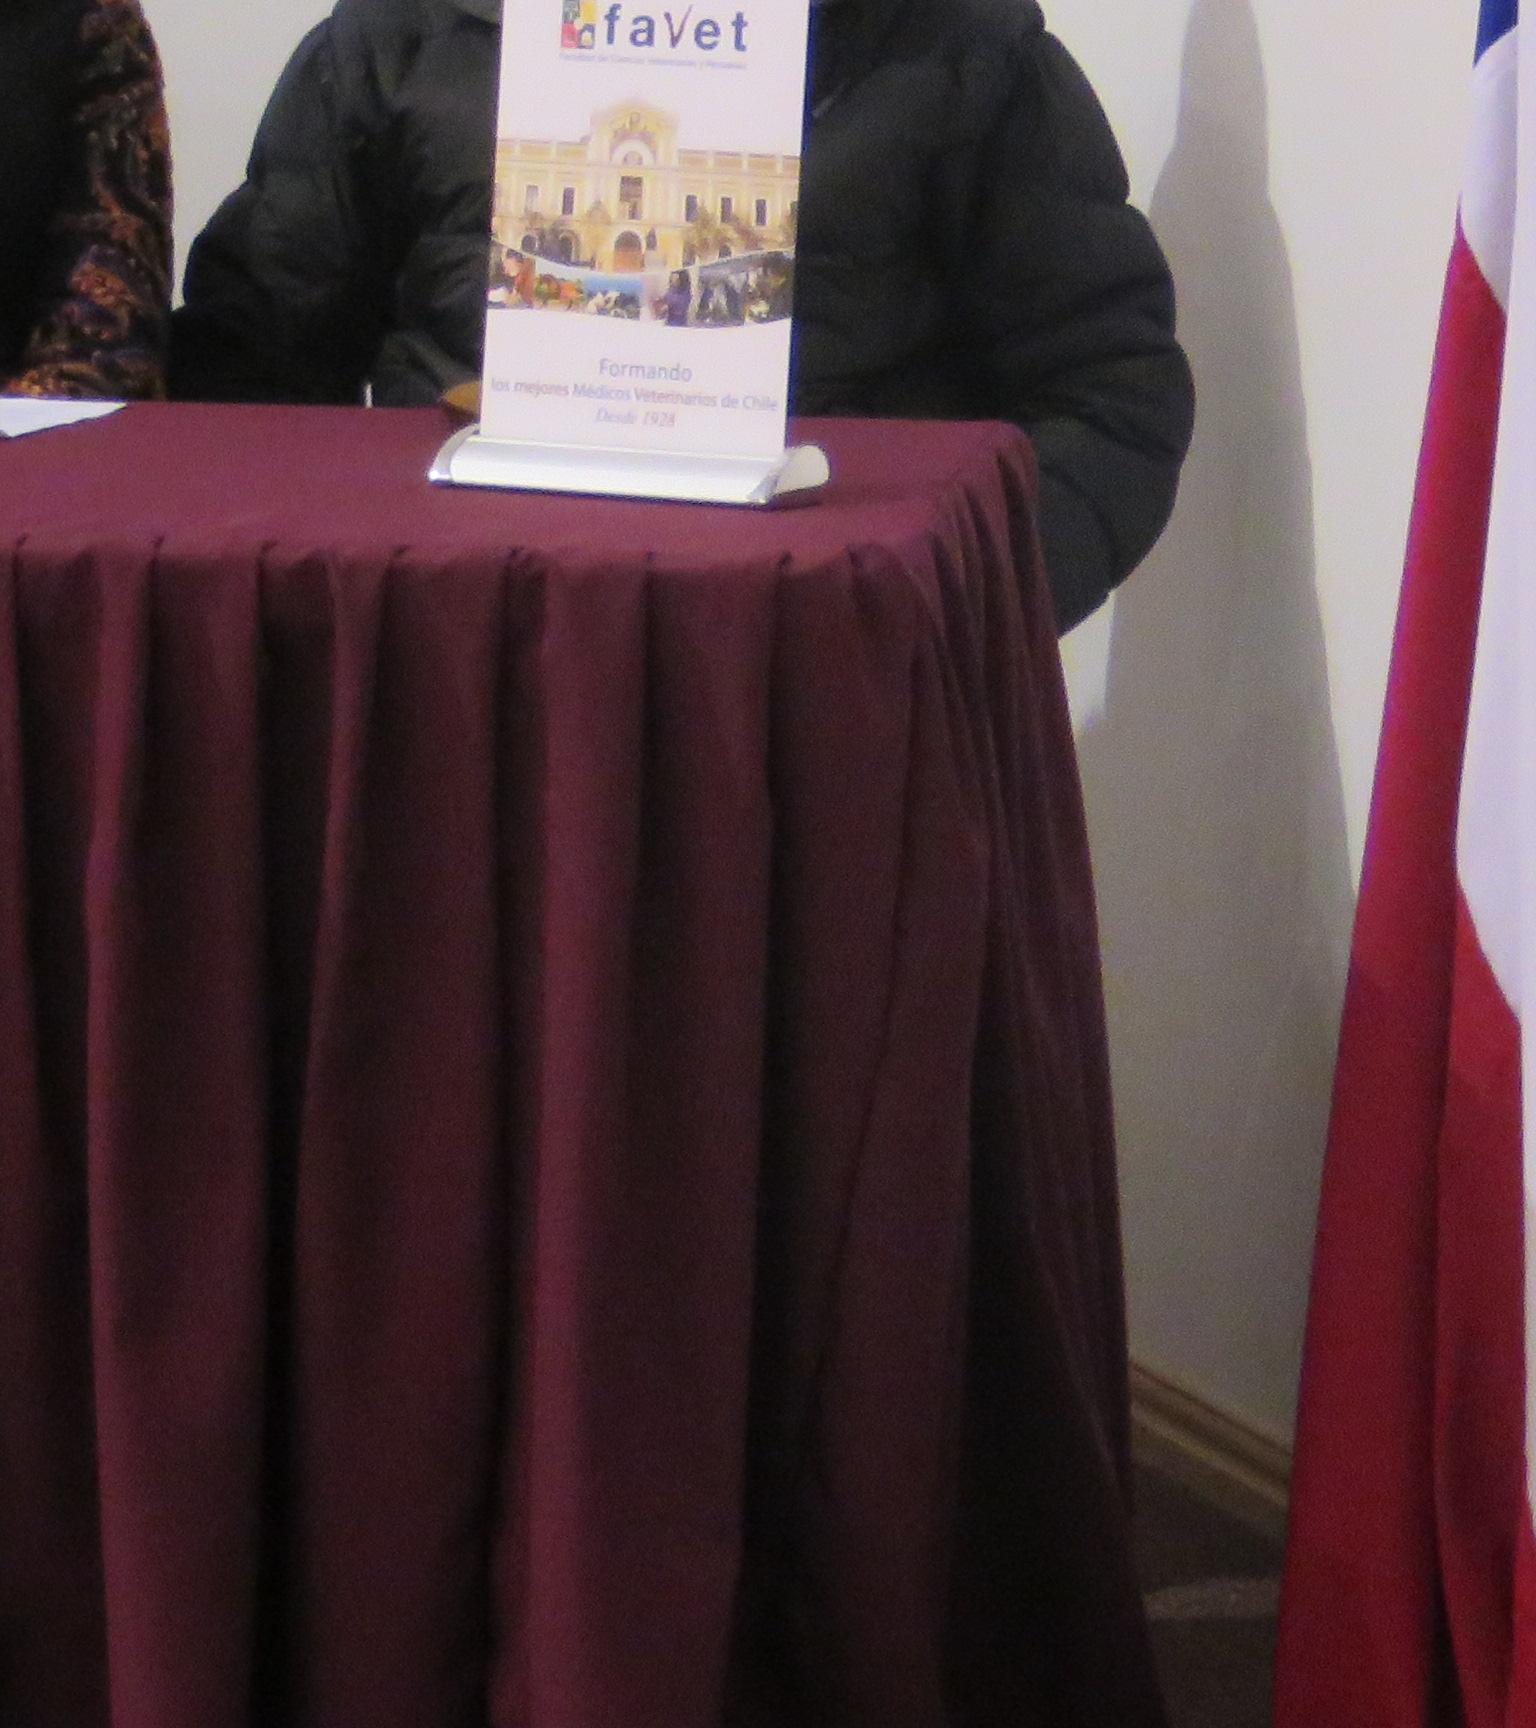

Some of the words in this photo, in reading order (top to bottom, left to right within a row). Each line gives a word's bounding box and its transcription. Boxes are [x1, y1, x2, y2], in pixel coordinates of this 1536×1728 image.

[599, 357, 693, 382] Formando
[514, 381, 569, 399] mejores
[634, 386, 717, 408] Veterinarios
[721, 393, 739, 409] de
[742, 394, 779, 411] Chile
